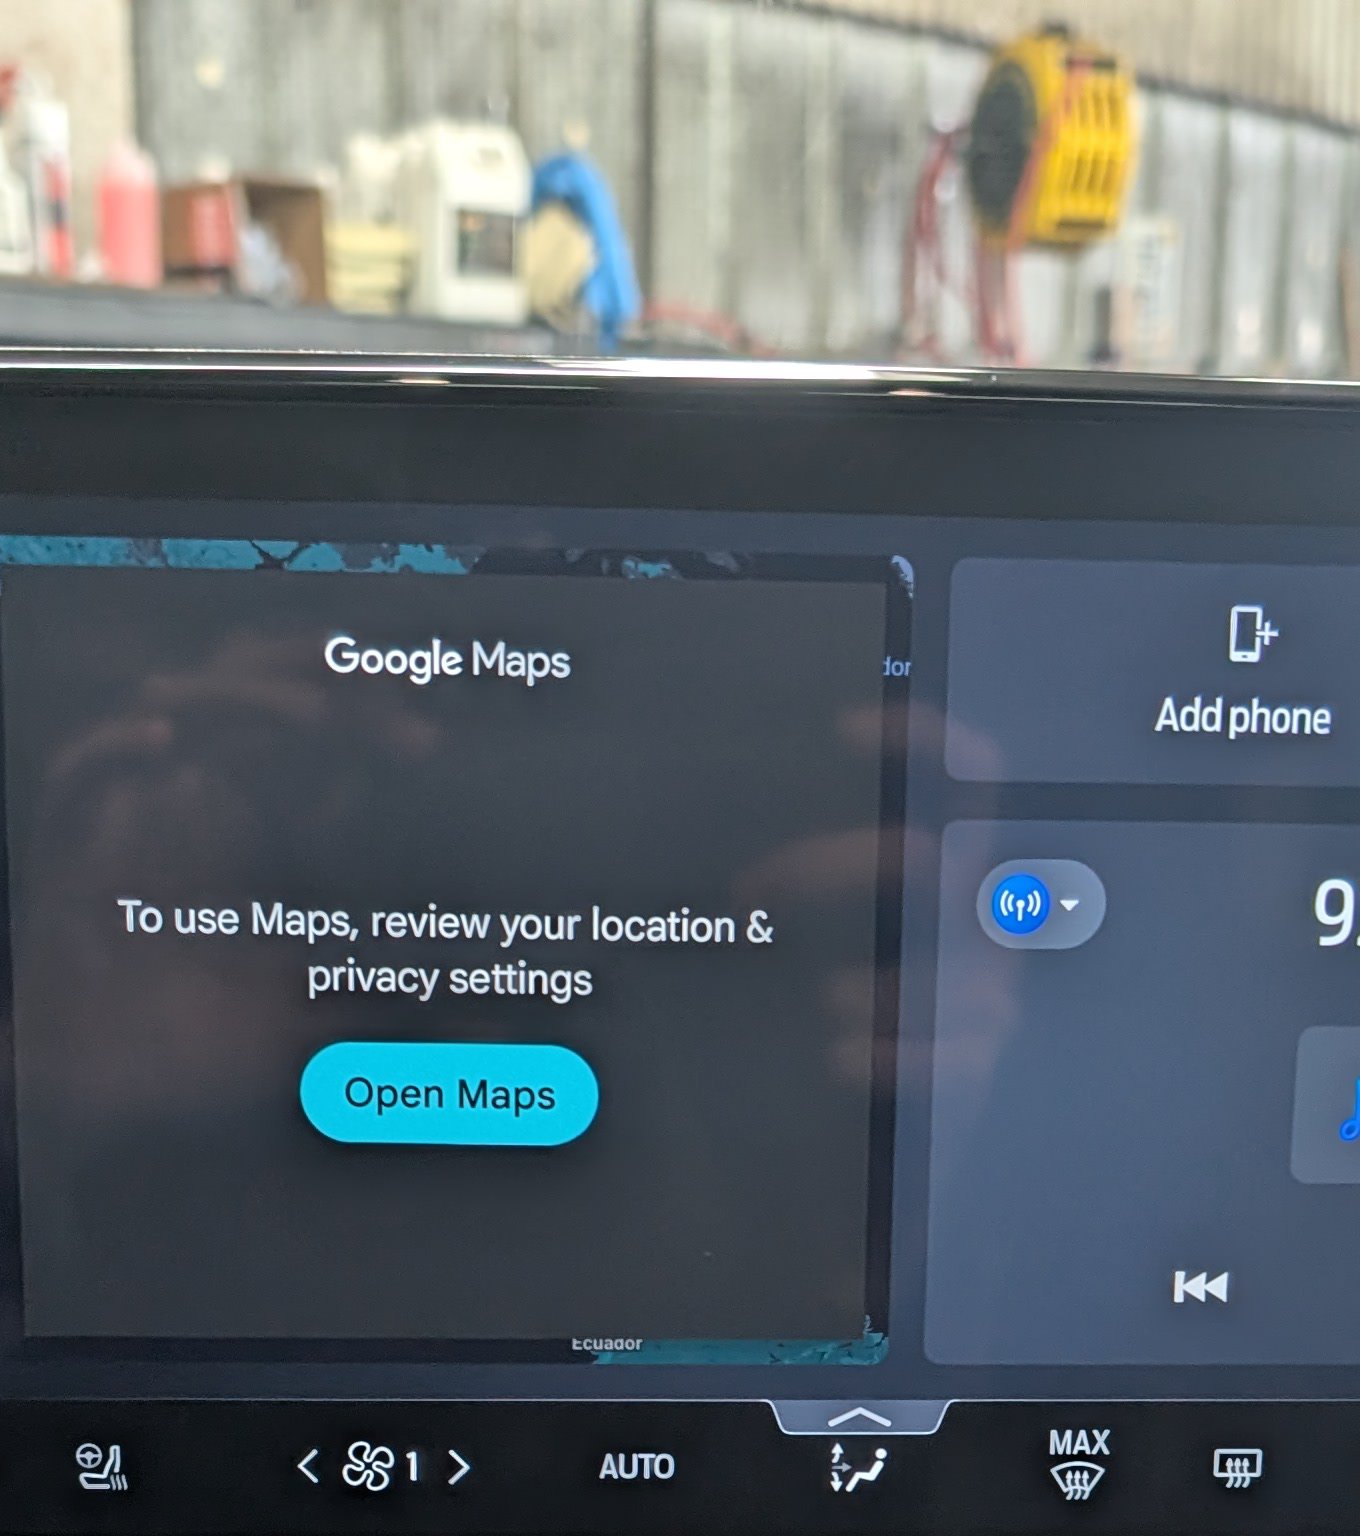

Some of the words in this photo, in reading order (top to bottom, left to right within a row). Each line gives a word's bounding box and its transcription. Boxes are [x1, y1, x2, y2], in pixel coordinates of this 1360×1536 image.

[324, 635, 463, 685] Google
[472, 640, 571, 687] Maps
[1154, 695, 1223, 733] Add
[1228, 696, 1332, 740] phone
[117, 899, 163, 934] To
[174, 908, 240, 935] use
[251, 901, 359, 945] Maps,
[371, 902, 491, 940] review
[499, 912, 582, 948] your
[592, 905, 735, 943] location
[746, 909, 774, 944] &
[308, 956, 441, 1002] privacy
[449, 959, 593, 1004] settings
[345, 1076, 444, 1116] Open
[458, 1078, 556, 1118] Maps
[1048, 1428, 1111, 1457] MAX
[405, 1451, 419, 1483] 1
[598, 1452, 676, 1481] AUTO
